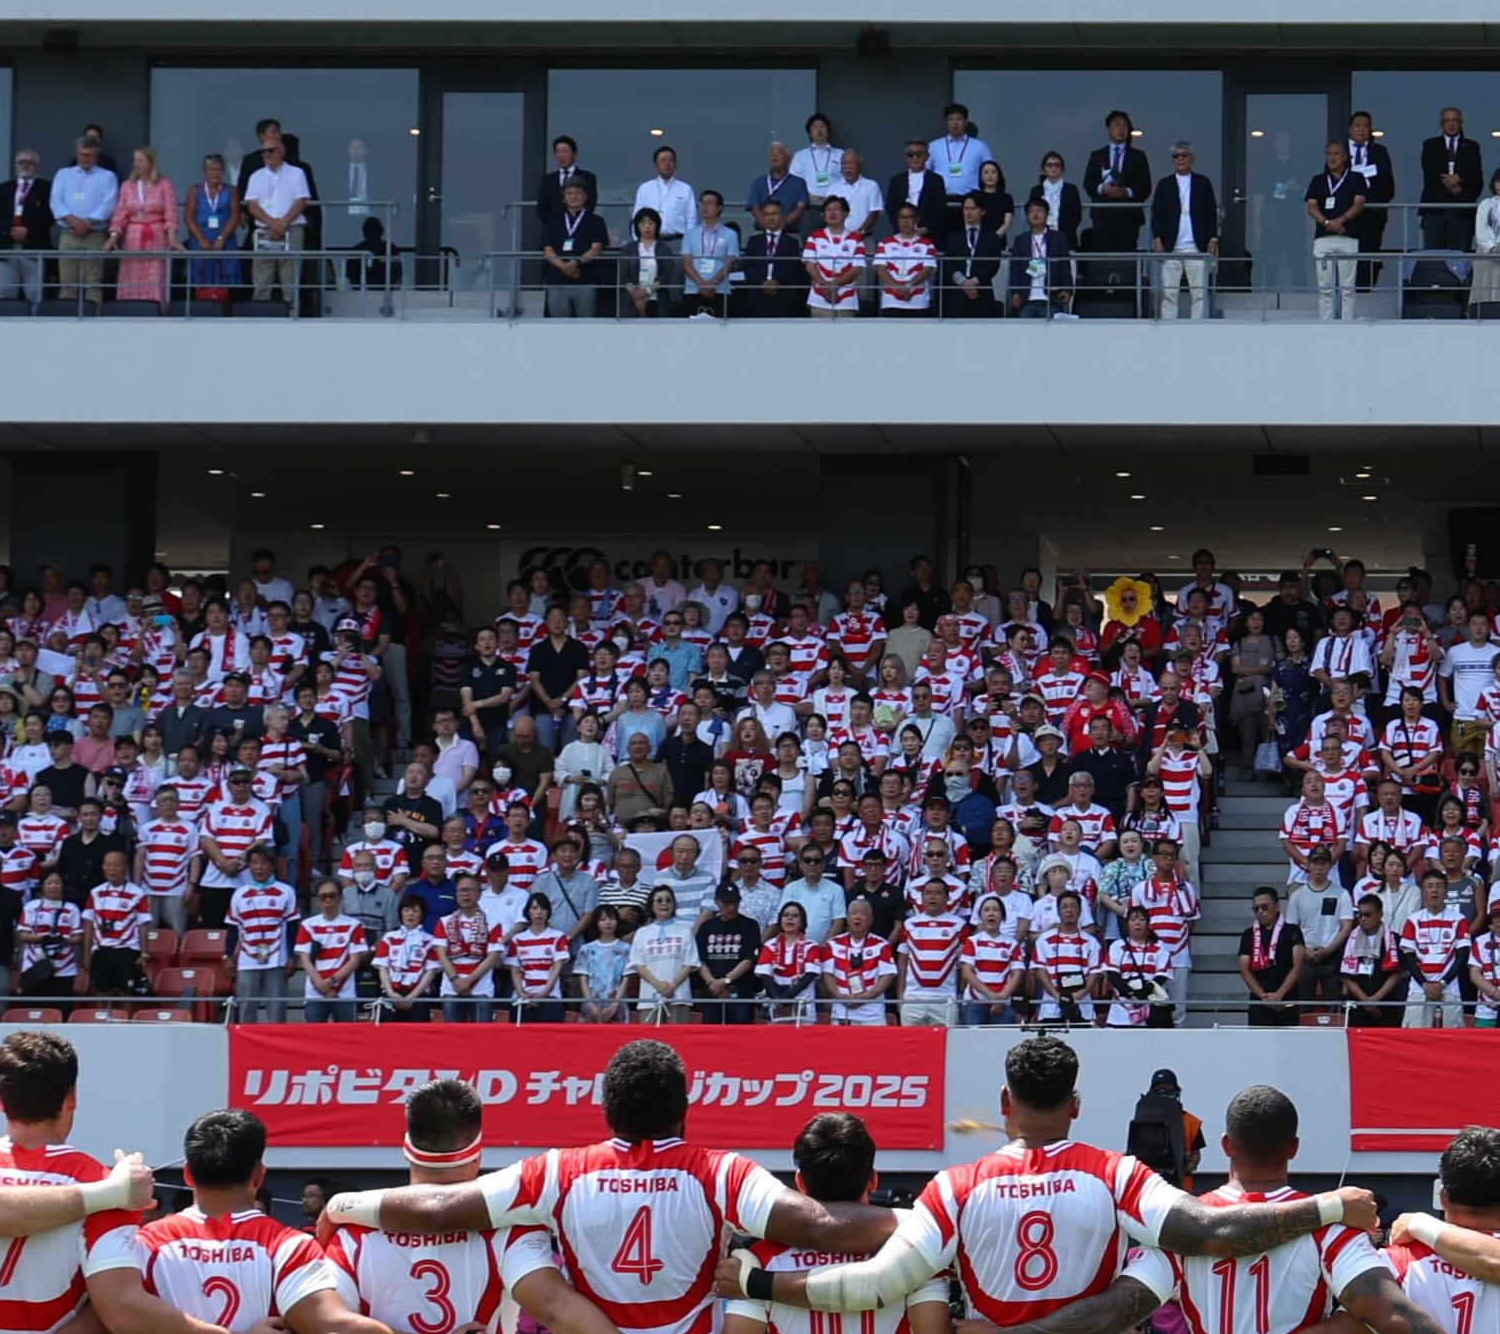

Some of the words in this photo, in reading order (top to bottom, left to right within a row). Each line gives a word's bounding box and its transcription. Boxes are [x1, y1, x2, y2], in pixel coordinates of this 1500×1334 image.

[597, 1176, 679, 1194] TOSHIBA
[996, 1177, 1076, 1200] TOSHIBA
[386, 1227, 469, 1247] TOSHIBA
[611, 1205, 664, 1286] 4
[180, 1245, 255, 1264] TOSHIBA
[1014, 1210, 1058, 1291] 8
[202, 1276, 240, 1328] 2
